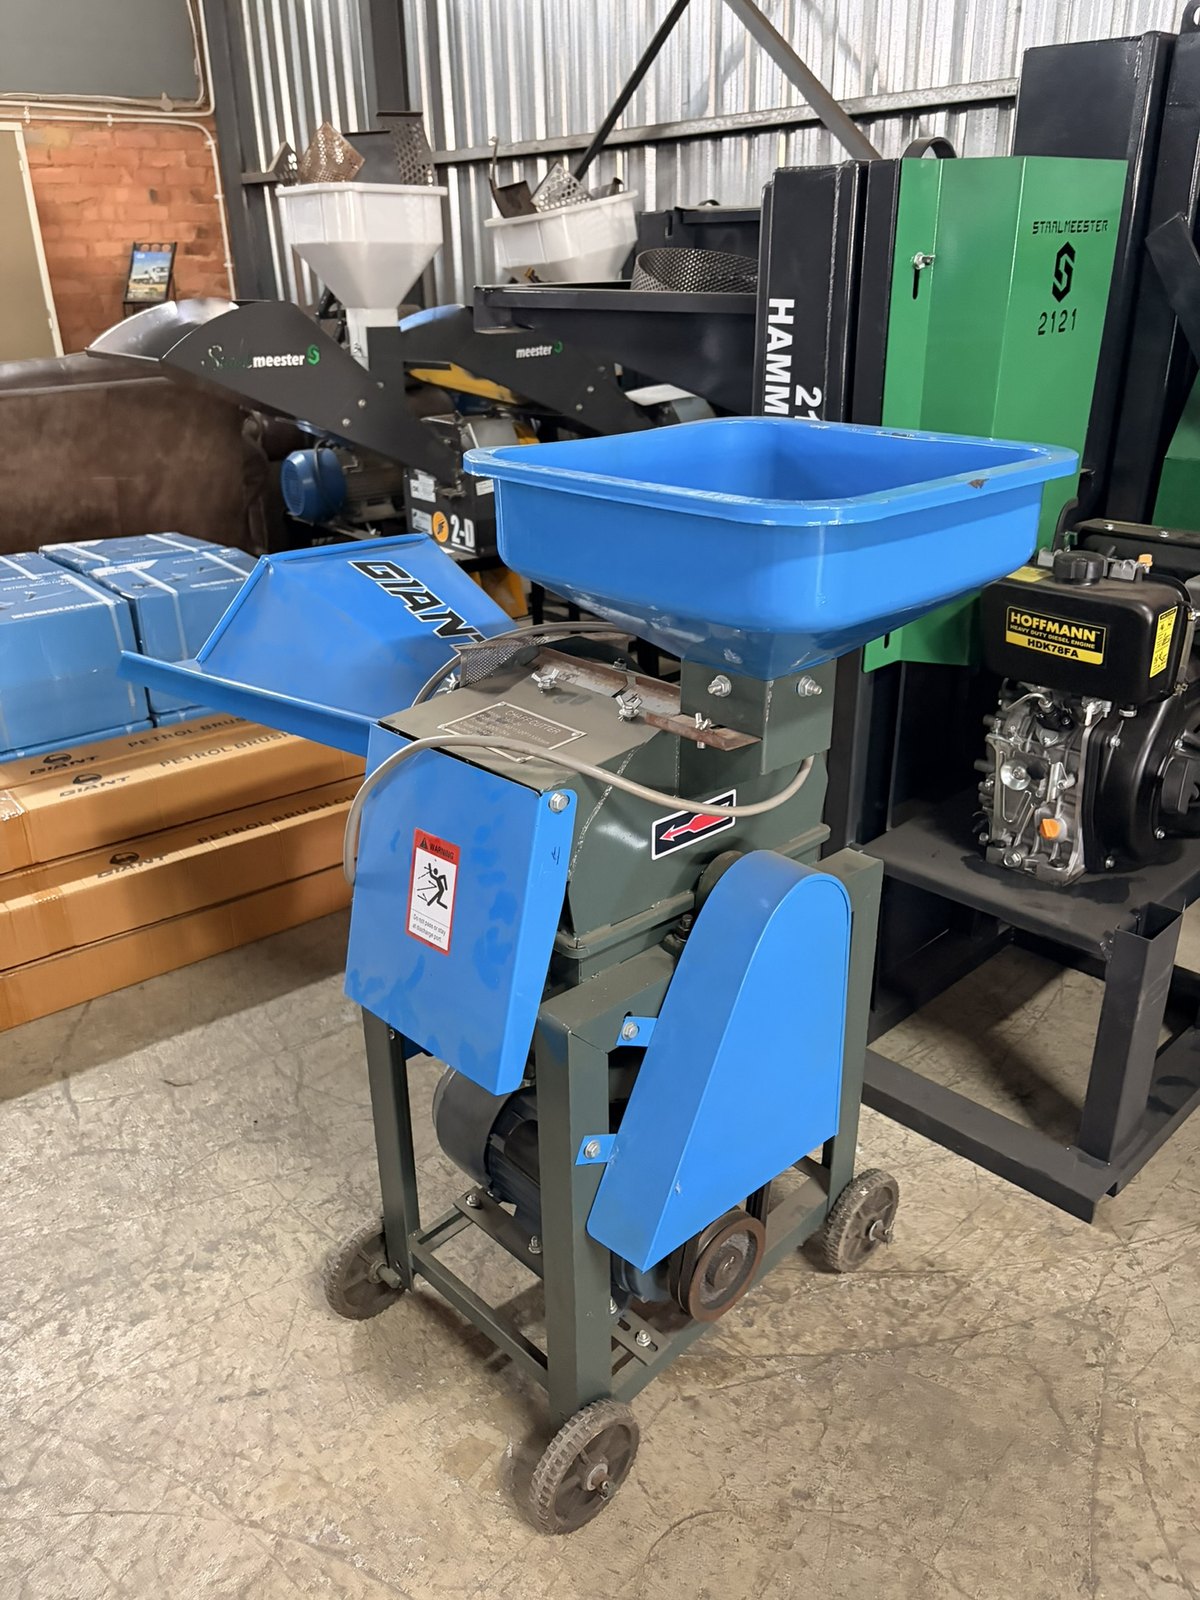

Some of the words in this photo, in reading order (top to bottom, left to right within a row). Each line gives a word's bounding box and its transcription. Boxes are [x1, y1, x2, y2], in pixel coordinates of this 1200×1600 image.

[1032, 220, 1108, 235] STAALMEESTER
[1037, 308, 1077, 336] 2121
[252, 353, 305, 368] meester
[515, 345, 553, 359] meester
[450, 514, 476, 548] 2-D
[1010, 611, 1096, 642] HOFFMANN
[1010, 624, 1030, 634] HEAVY
[1030, 629, 1047, 638] DUTY
[1048, 634, 1070, 644] DIESEL
[1071, 638, 1095, 649] ENGINE
[1027, 638, 1079, 658] HDK78FA
[128, 728, 199, 748] PETROL
[30, 755, 99, 776] GIANT
[159, 747, 232, 767] PETROL
[60, 775, 130, 797] GIANT
[197, 820, 267, 844] PETROL
[271, 803, 332, 822] BRUSH
[430, 843, 454, 860] WARNING
[97, 854, 169, 879] GIANT
